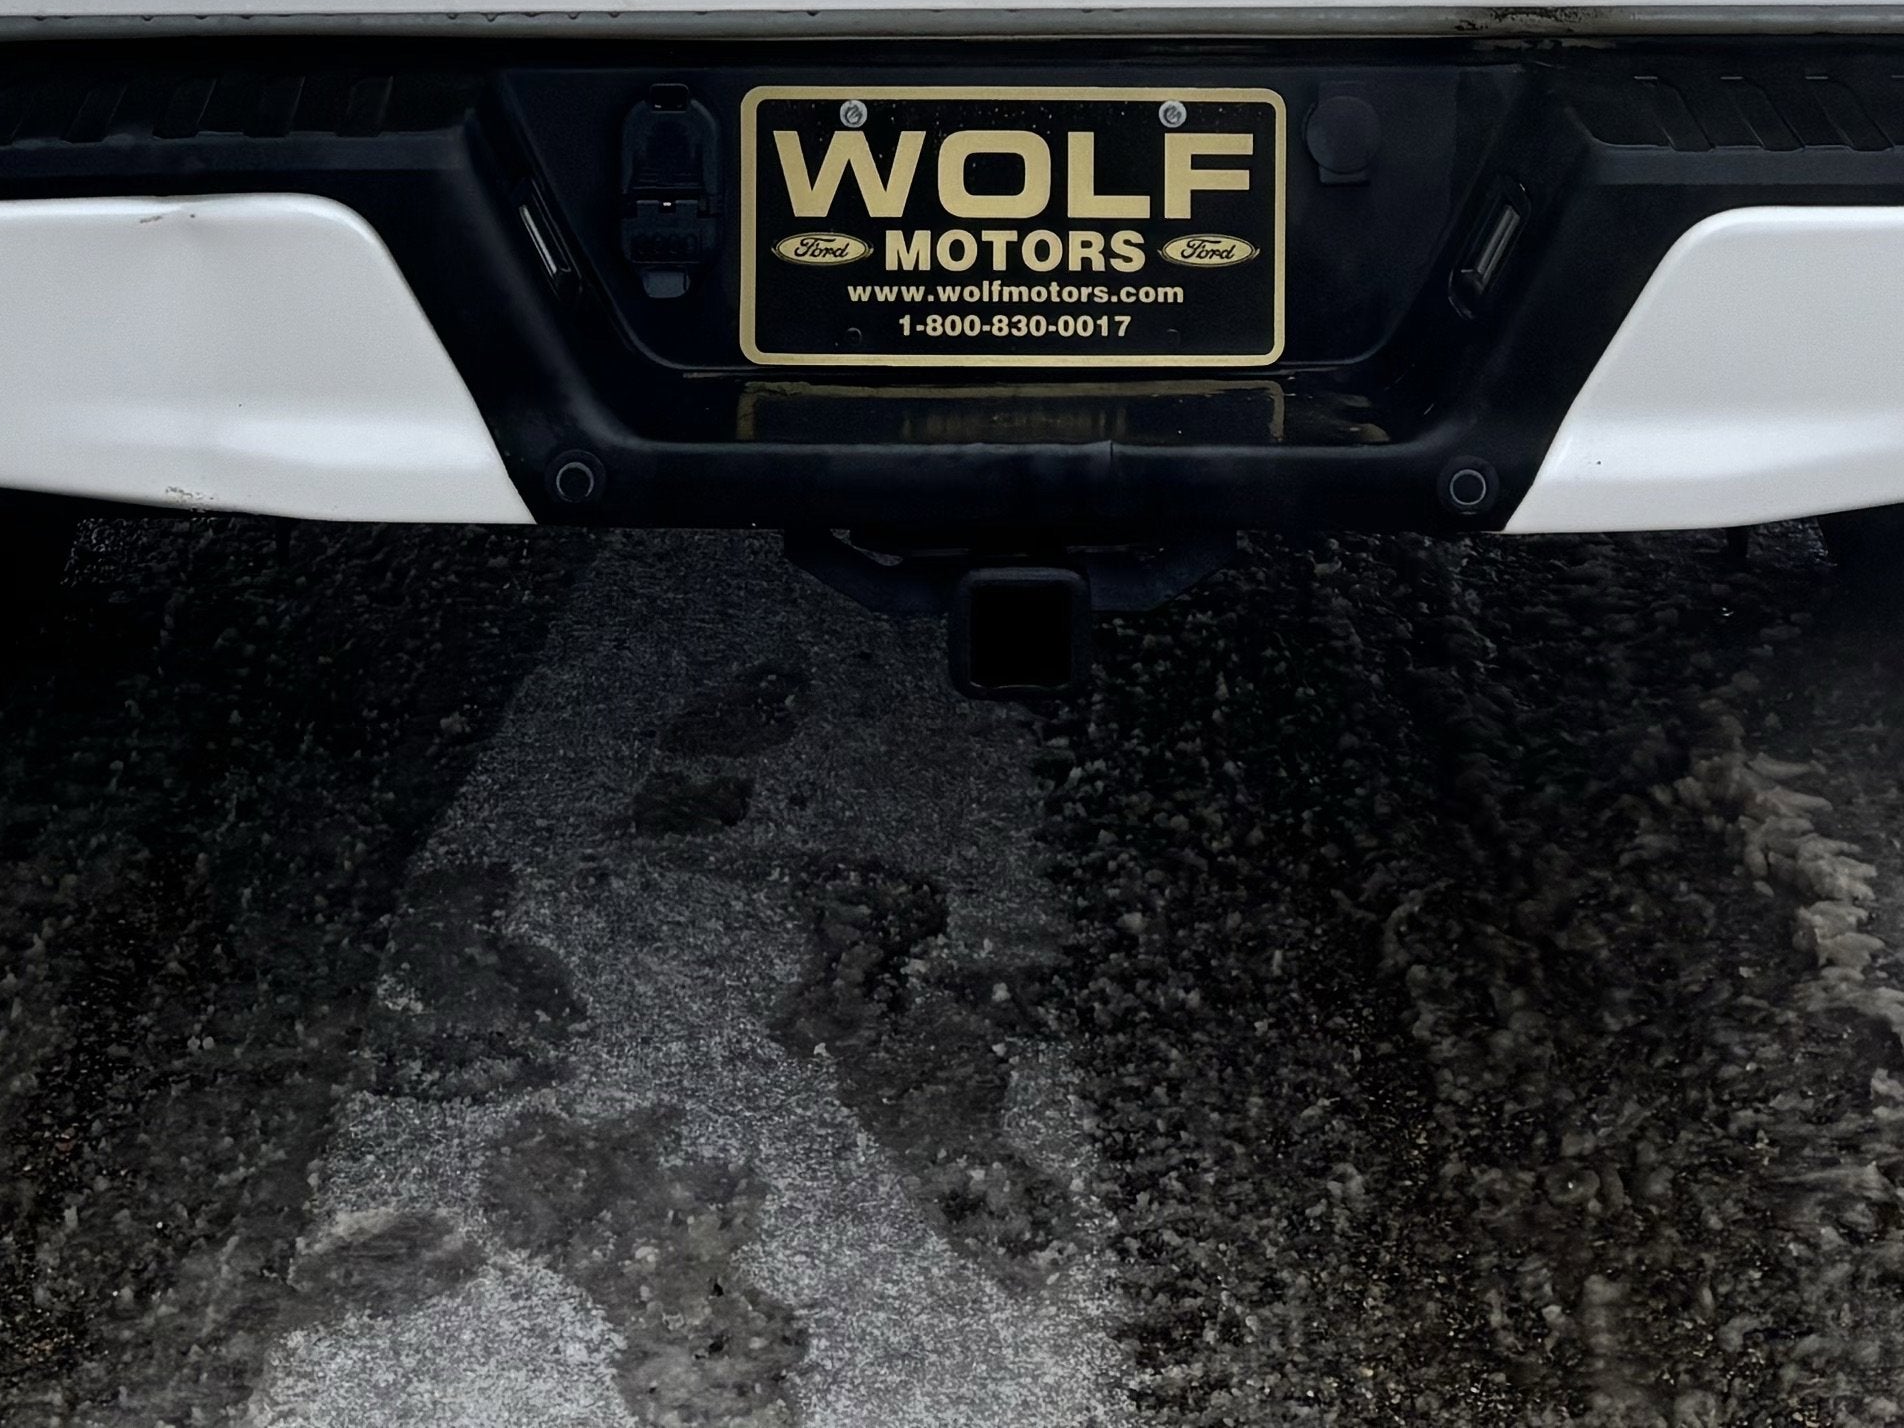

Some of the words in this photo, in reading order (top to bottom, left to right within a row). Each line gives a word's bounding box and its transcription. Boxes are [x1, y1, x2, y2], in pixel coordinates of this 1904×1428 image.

[773, 129, 1254, 219] WOLF
[793, 236, 850, 261] Ford
[884, 229, 1147, 273] MOTORS
[1179, 237, 1236, 262] Ford
[847, 280, 1184, 304] www.wolfmotors.com
[898, 314, 1132, 338] 1-800-830-0017
